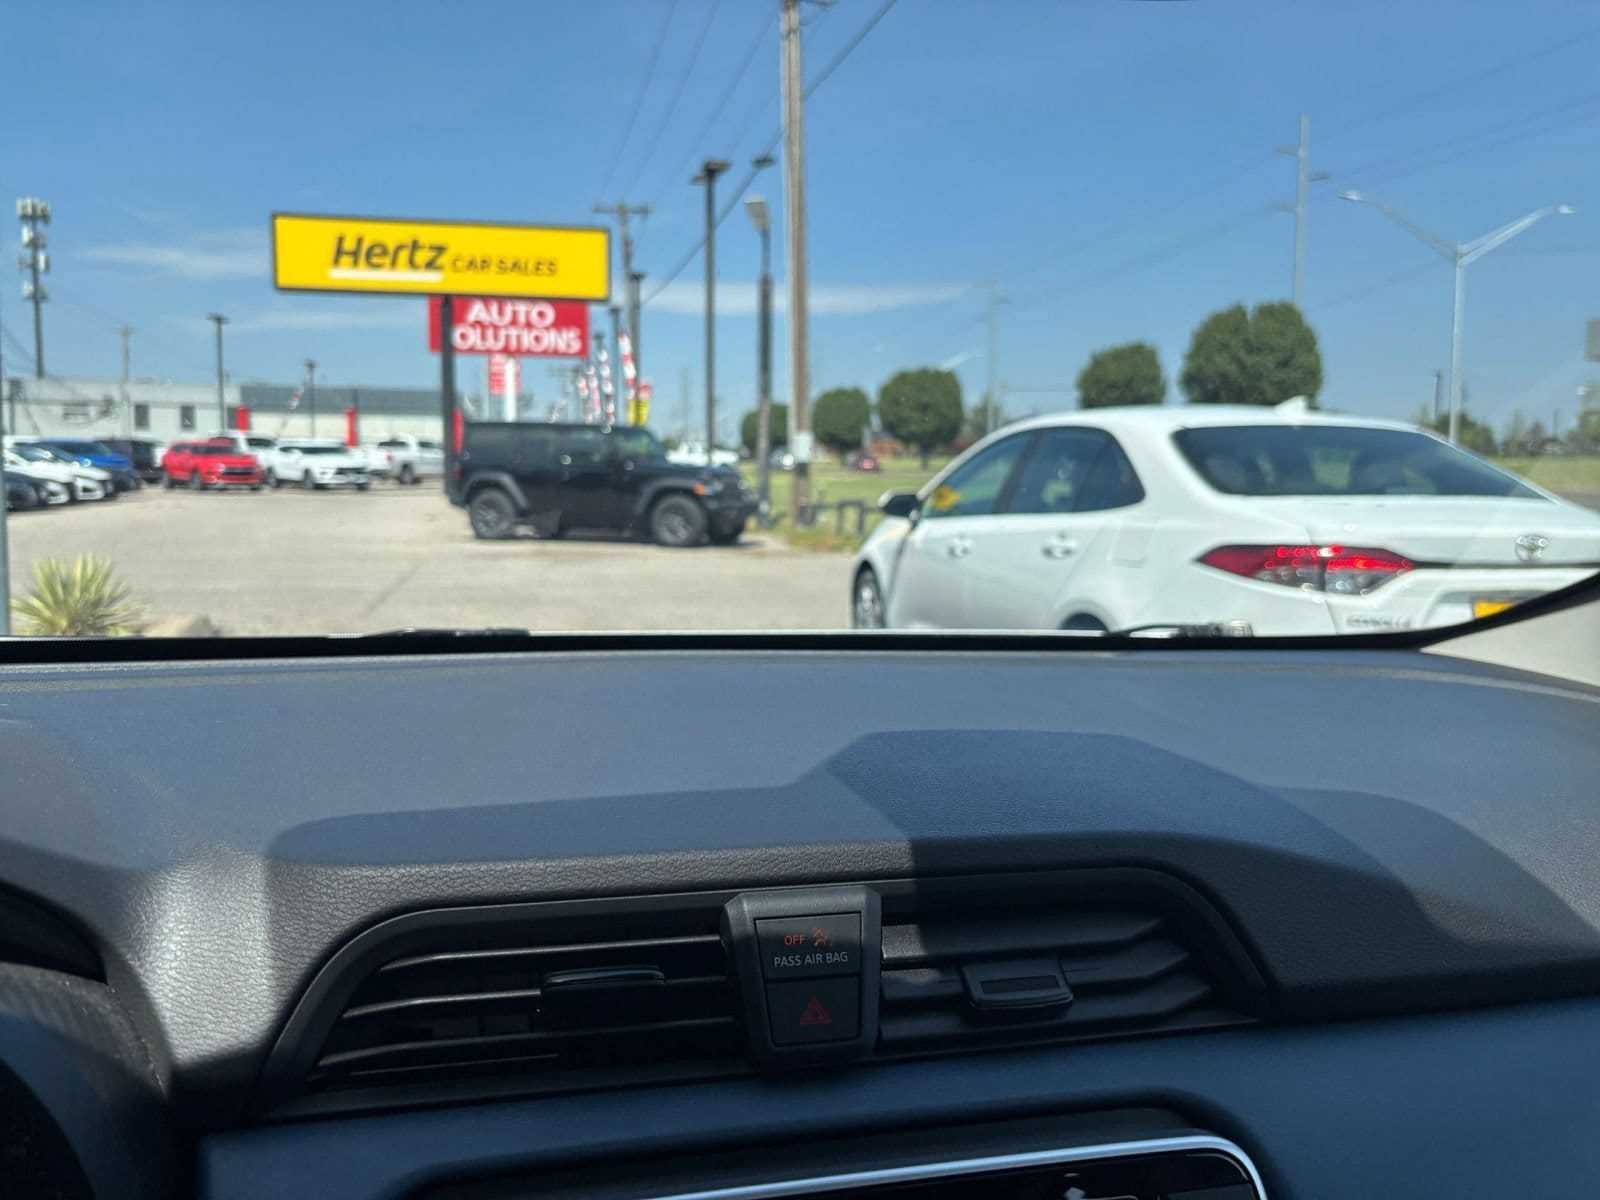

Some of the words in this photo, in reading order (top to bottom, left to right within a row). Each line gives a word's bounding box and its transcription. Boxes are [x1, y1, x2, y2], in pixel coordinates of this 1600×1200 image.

[332, 233, 448, 271] Hertz
[452, 256, 490, 273] CAR
[496, 258, 558, 276] SALES
[466, 299, 555, 328] AUTO
[452, 323, 582, 353] OLUTIONS
[784, 934, 806, 946] OFF
[774, 956, 801, 968] PASS
[804, 953, 823, 966] AIR
[826, 951, 848, 963] BAG
